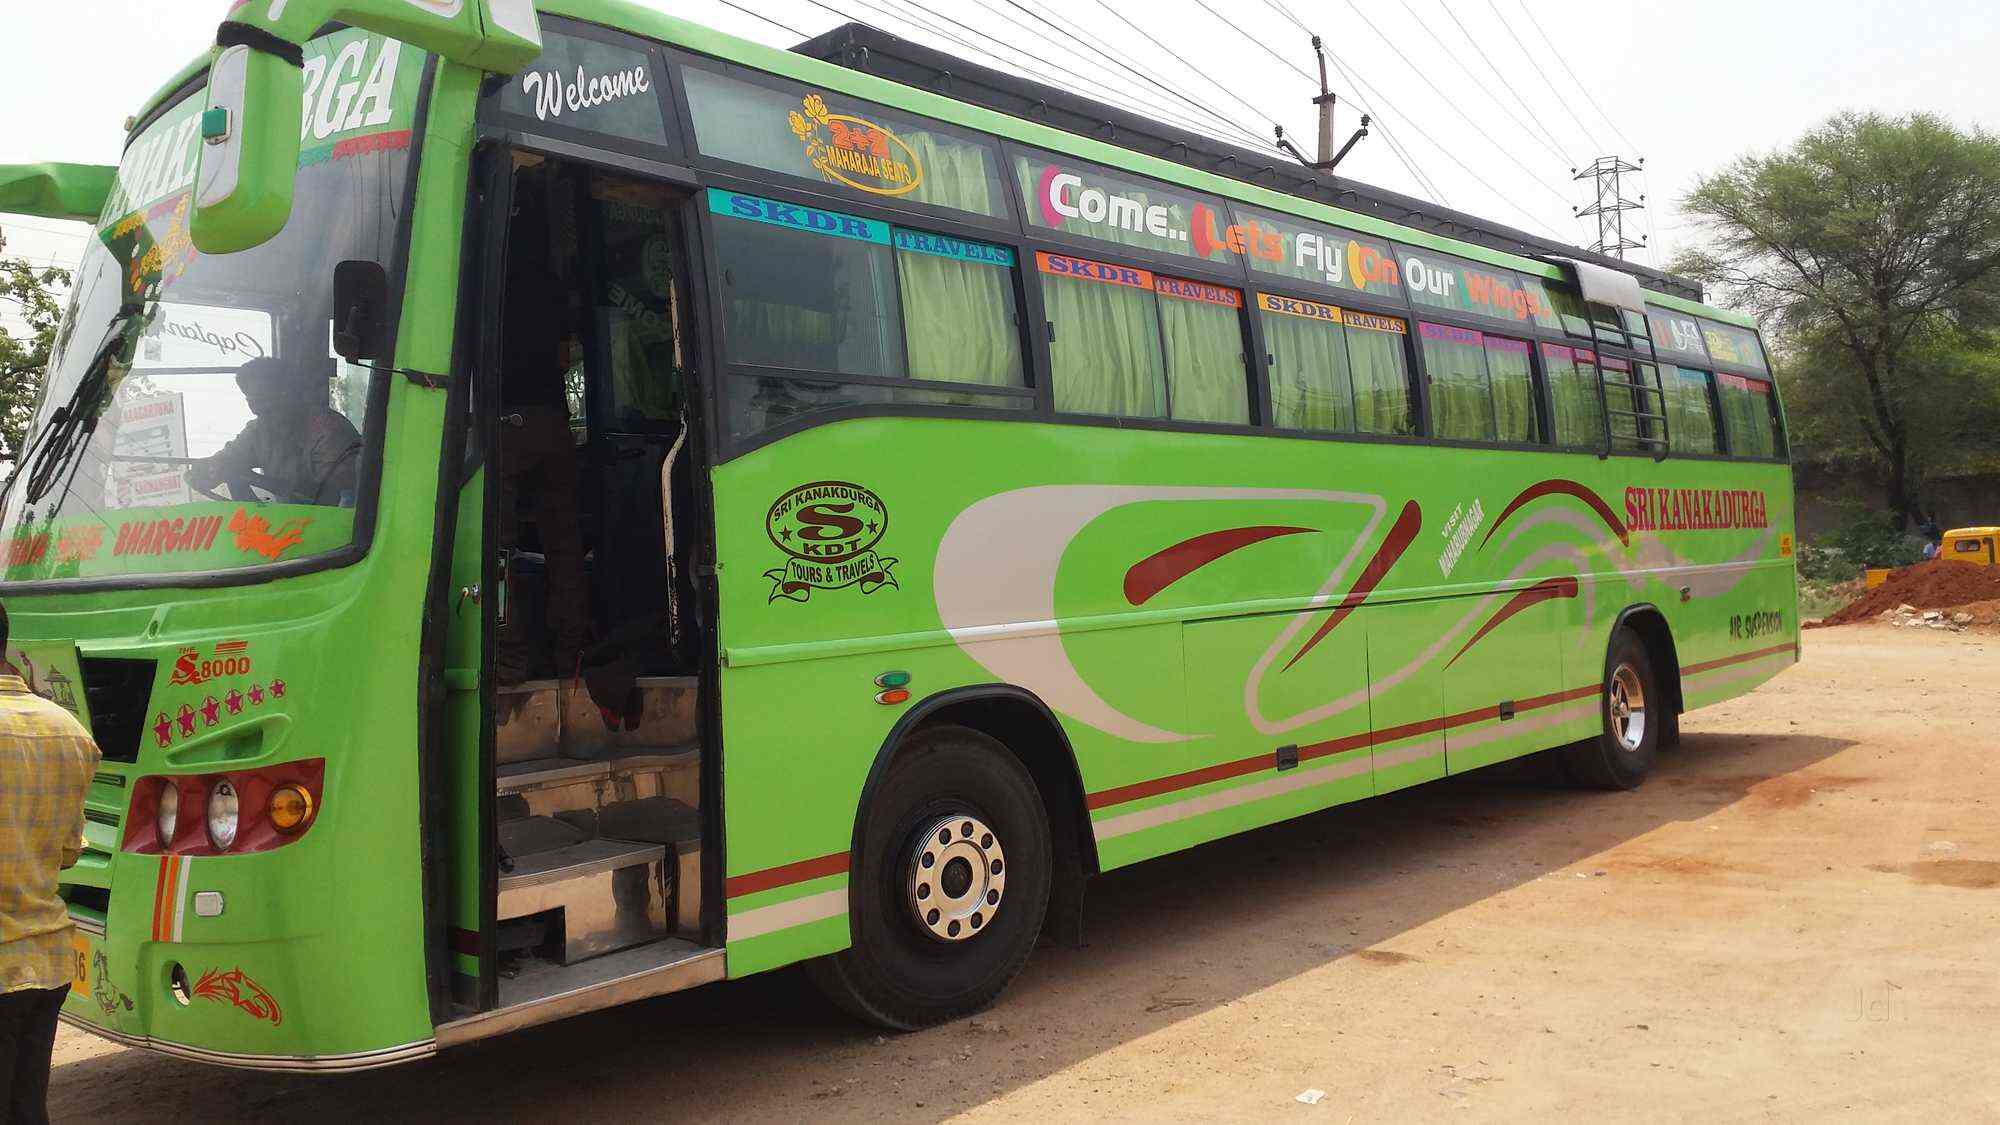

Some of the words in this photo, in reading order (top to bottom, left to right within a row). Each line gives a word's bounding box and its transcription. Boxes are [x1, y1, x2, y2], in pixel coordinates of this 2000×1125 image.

[522, 65, 649, 121] Welcome
[827, 120, 890, 160] 2+2
[825, 145, 881, 178] MAHARAJA
[881, 158, 912, 185] SEATS
[730, 195, 872, 239] SKDR
[897, 231, 1009, 263] TRAVELS
[1047, 254, 1142, 286] SKDR
[1153, 278, 1237, 306] TRAVELS
[1295, 232, 1342, 282] Fly
[1359, 246, 1398, 286] On
[1405, 257, 1455, 297] Our
[1266, 295, 1334, 319] SKDR
[1343, 311, 1403, 333] TRAVELS
[774, 499, 792, 522] SRI
[795, 487, 881, 514] KANAKDURGA
[1624, 486, 1656, 531] SRI
[1658, 488, 1768, 530] KANAKADURGA
[112, 516, 223, 556] BHARGAVI
[802, 537, 862, 556] KDT
[790, 560, 823, 583] TOURS
[825, 566, 834, 583] &
[835, 554, 876, 581] TRAVELS
[201, 656, 251, 679] 8000
